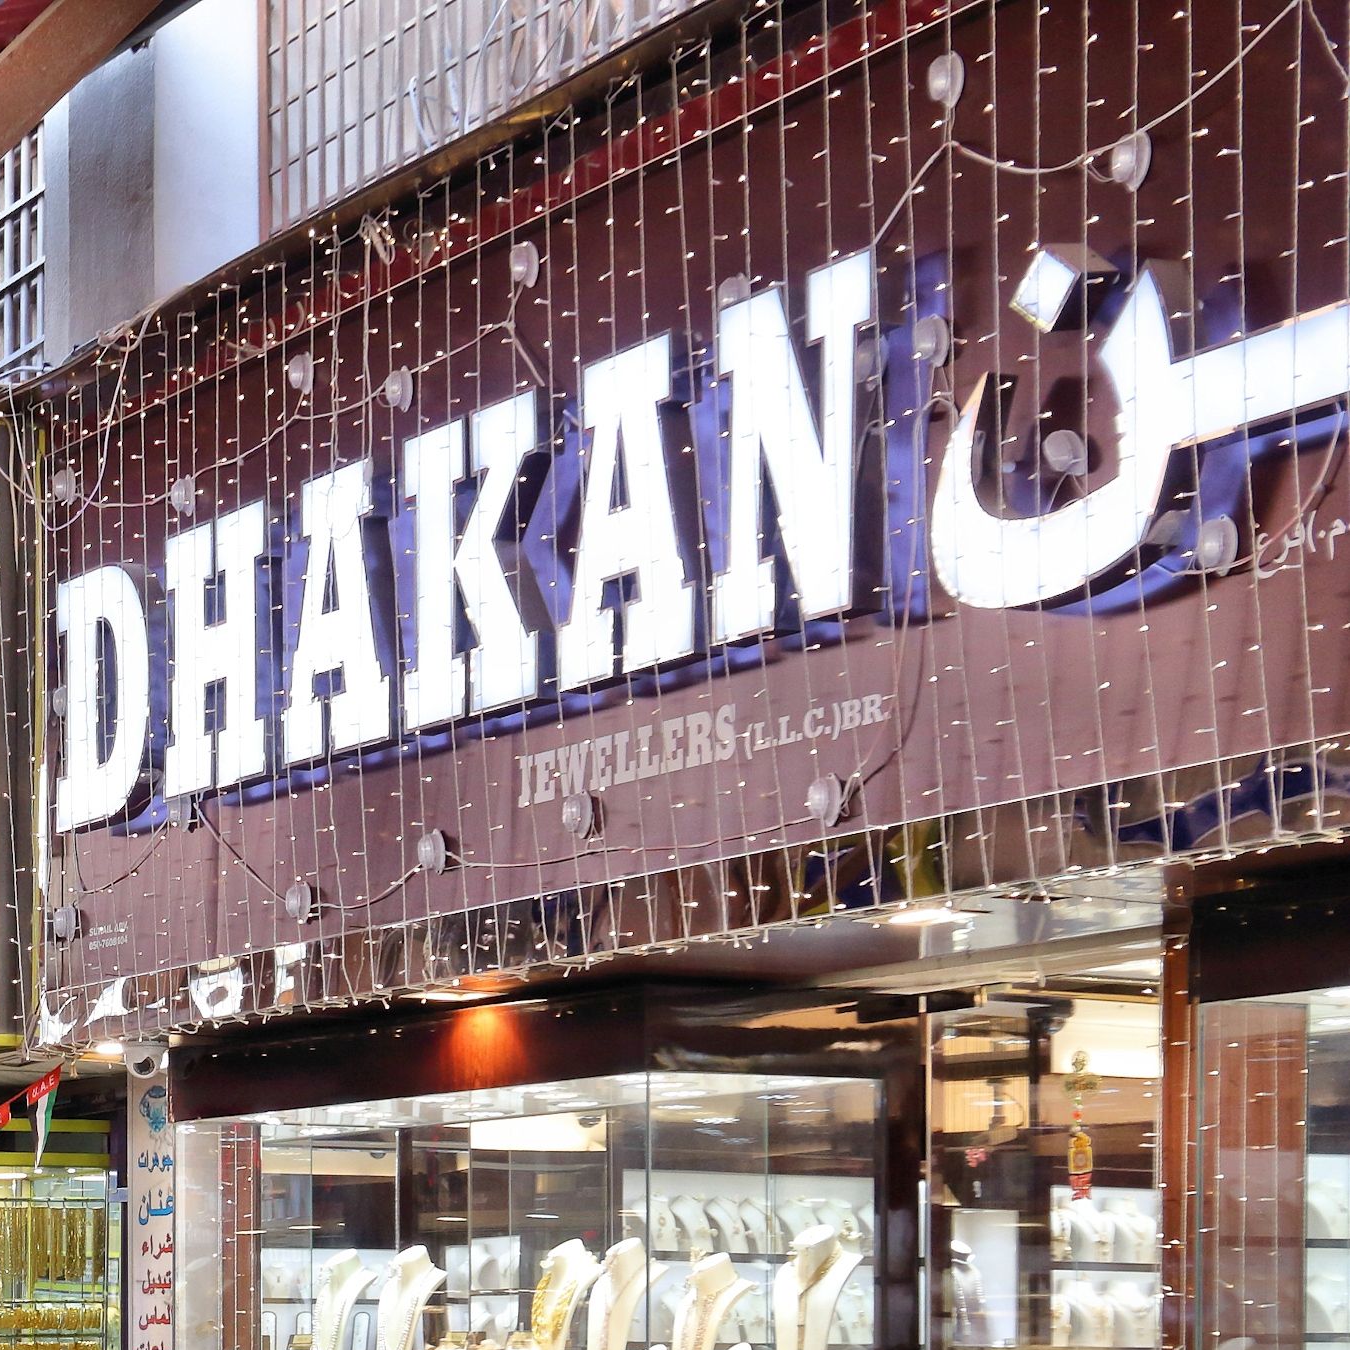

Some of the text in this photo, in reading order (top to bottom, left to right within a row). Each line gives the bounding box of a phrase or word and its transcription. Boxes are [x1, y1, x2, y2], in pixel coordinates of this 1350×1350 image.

[56, 247, 873, 834] DHAKAN
[517, 704, 737, 808] JEWELLERS
[138, 1189, 174, 1225] عنان
